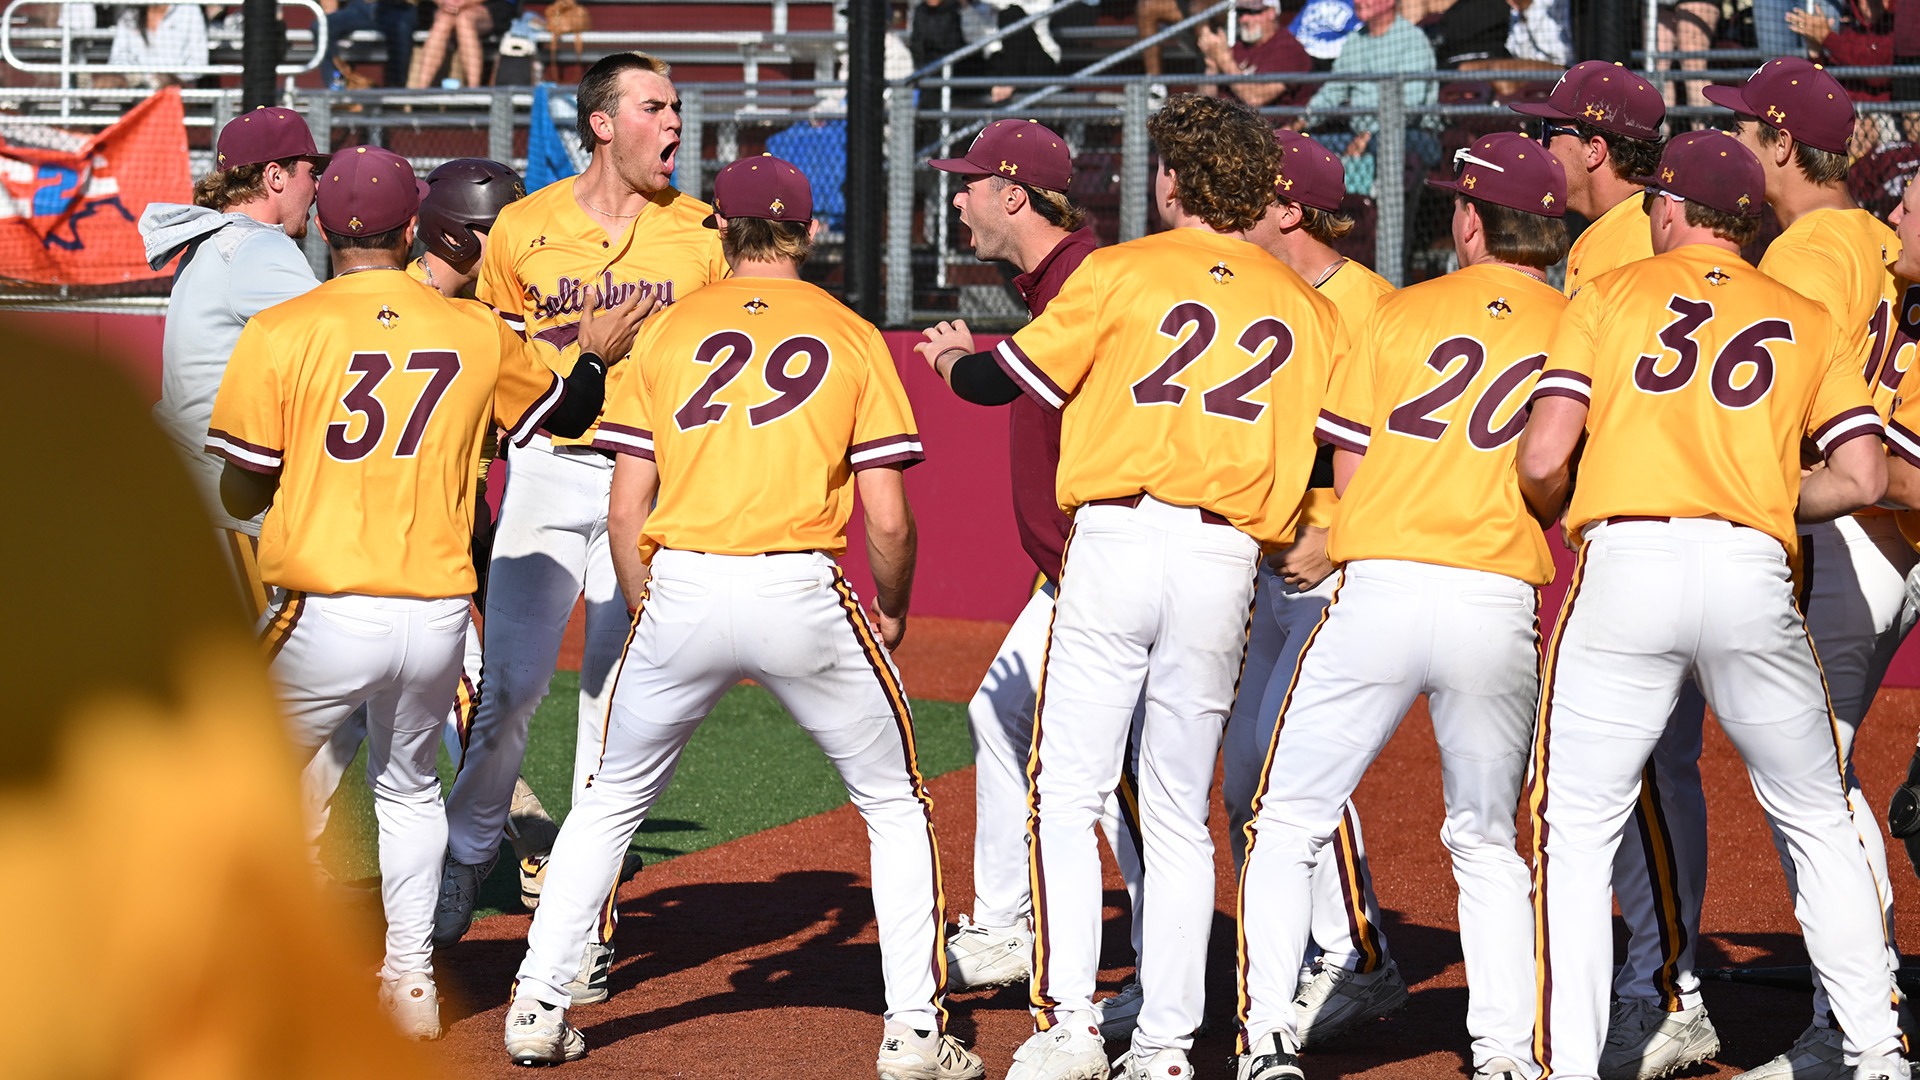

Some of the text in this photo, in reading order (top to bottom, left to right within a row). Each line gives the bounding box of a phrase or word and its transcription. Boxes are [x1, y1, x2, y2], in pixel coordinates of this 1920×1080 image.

[324, 348, 464, 464] 37
[672, 328, 833, 434] 29
[1129, 299, 1296, 425] 22
[1386, 334, 1549, 452] 20
[1632, 292, 1797, 411] 36
